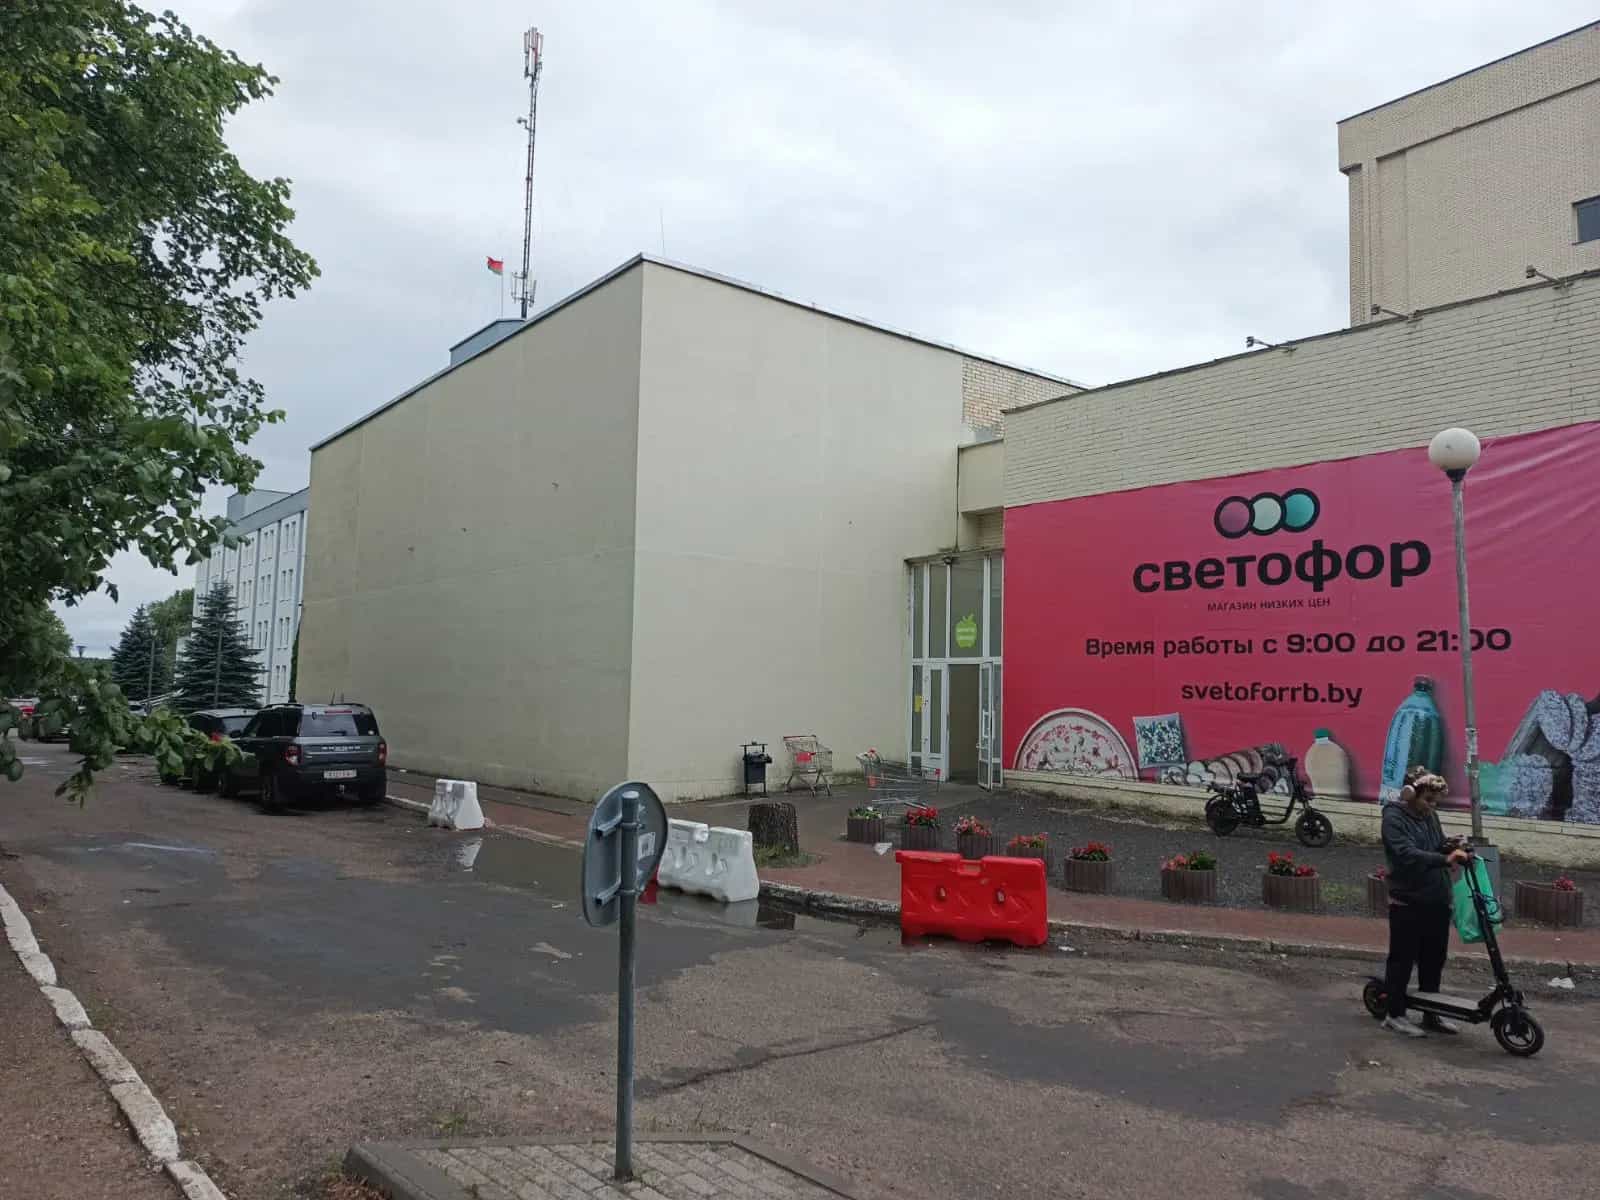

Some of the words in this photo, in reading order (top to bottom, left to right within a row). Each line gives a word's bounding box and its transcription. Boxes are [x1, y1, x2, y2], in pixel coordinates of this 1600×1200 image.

[1132, 539, 1432, 594] светофор
[1207, 602, 1257, 612] МАГАЗИН
[1260, 599, 1304, 609] НИЗКИХ
[1308, 598, 1330, 608] ЦЕН
[1086, 638, 1155, 659] Время
[1163, 636, 1253, 658] работы
[1262, 638, 1278, 654] с
[1286, 632, 1356, 653] 9:00
[1366, 635, 1406, 653] до
[1181, 681, 1363, 709] svetoforrb.by
